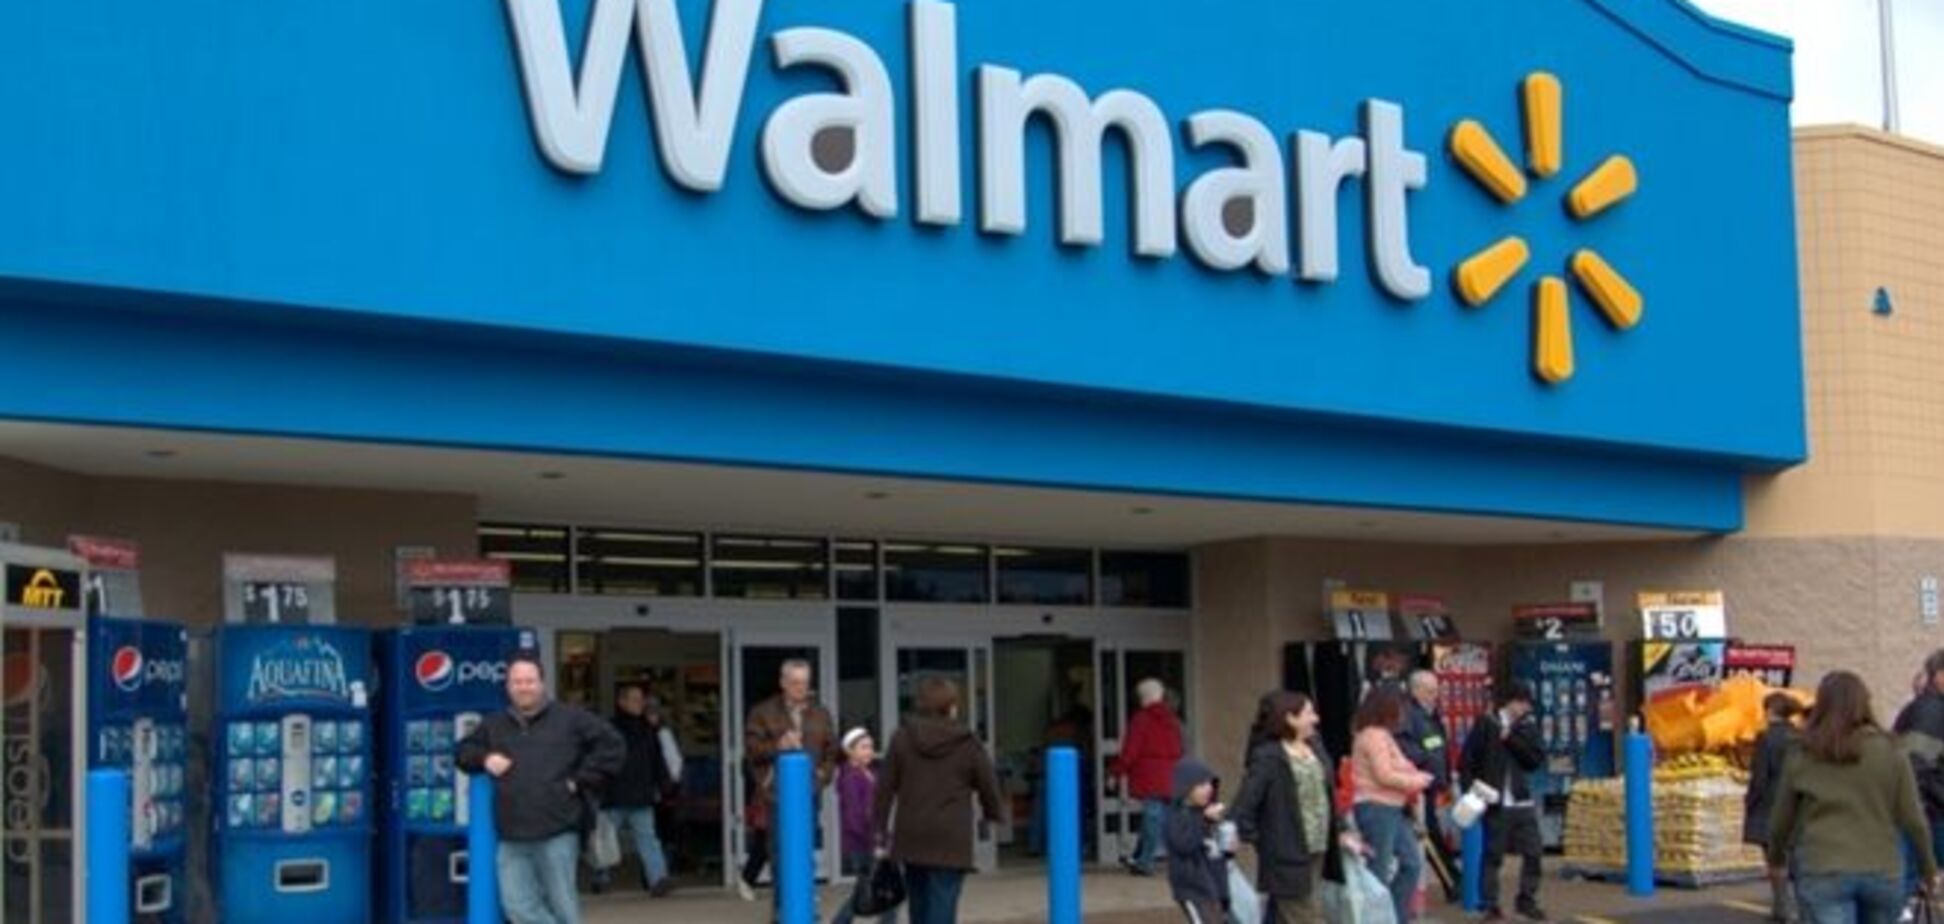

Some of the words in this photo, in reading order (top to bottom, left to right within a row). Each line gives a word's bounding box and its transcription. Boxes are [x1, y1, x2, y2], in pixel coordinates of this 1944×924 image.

[505, 0, 1431, 299] Walmart
[247, 653, 349, 699] AQUAFINA
[457, 660, 507, 685] pep
